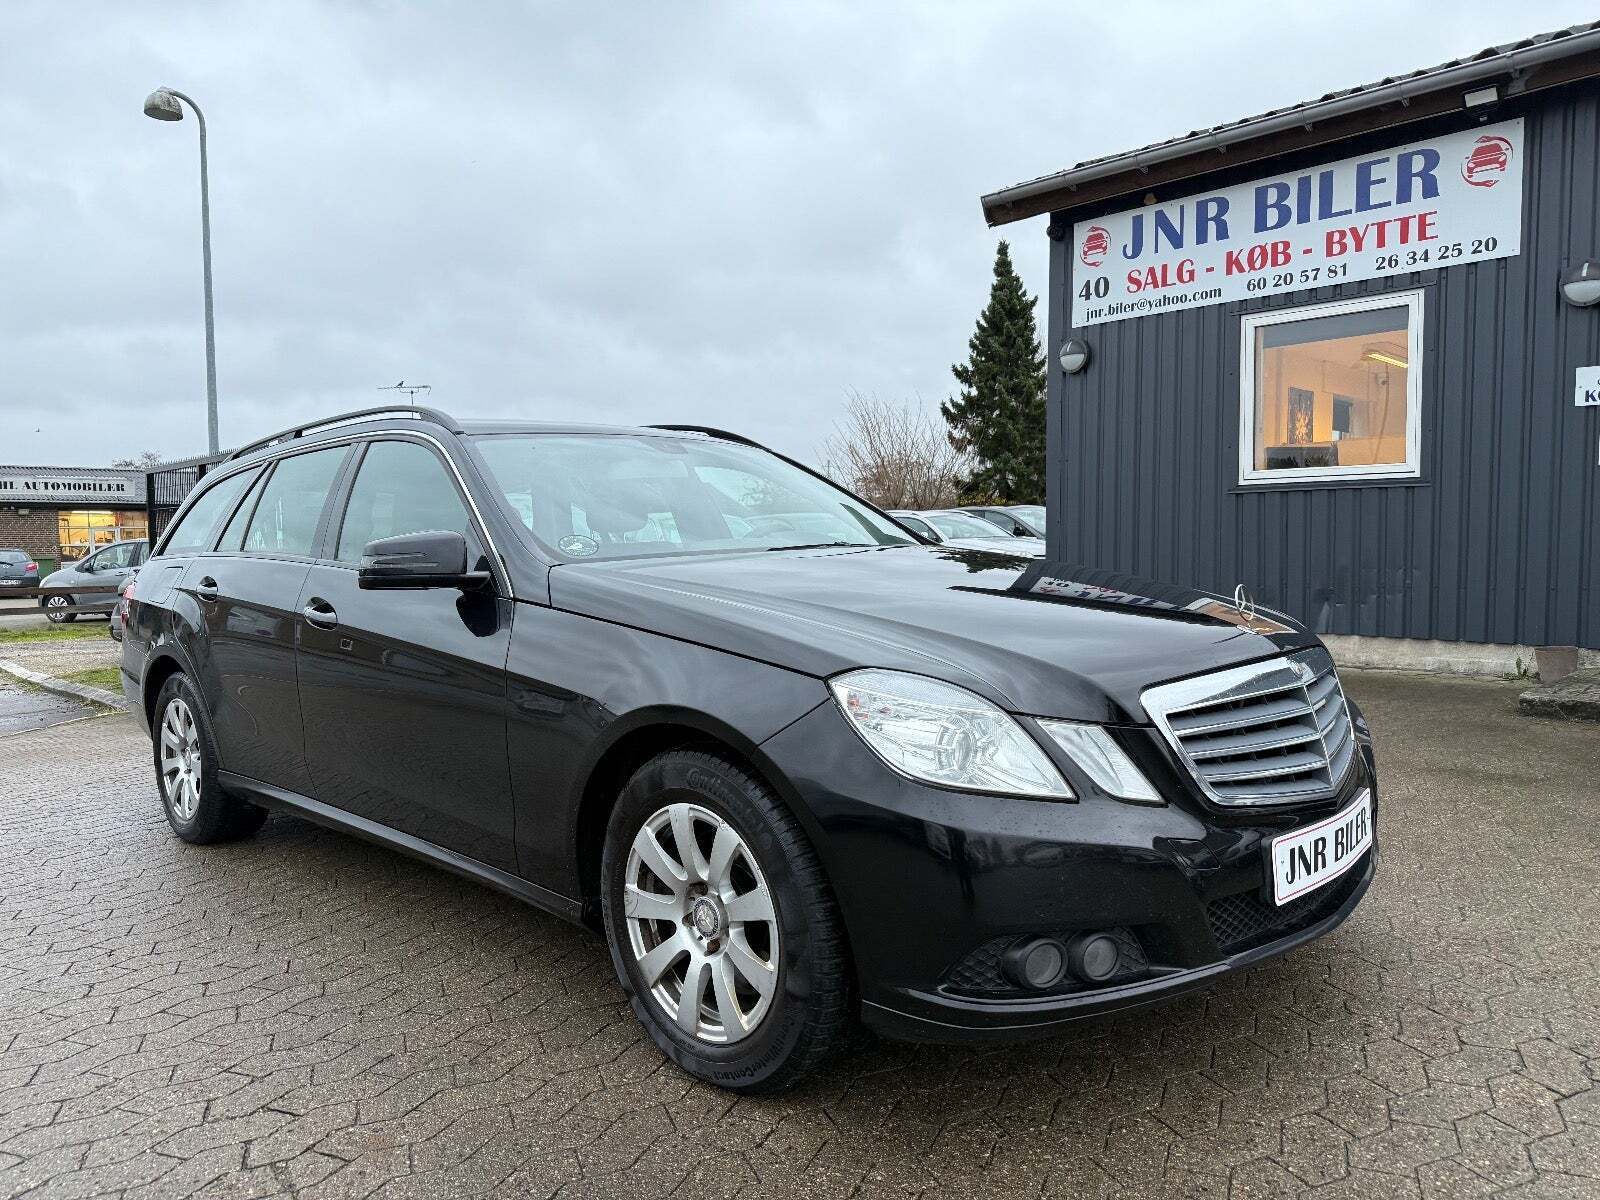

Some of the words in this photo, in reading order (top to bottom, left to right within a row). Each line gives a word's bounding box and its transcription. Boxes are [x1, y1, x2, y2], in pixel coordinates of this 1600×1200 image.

[1122, 197, 1230, 260] JNR
[1254, 149, 1440, 234] BILER
[1126, 259, 1196, 294] SALG
[1225, 240, 1292, 276] KØB
[1325, 211, 1439, 258] BYTTE
[1246, 276, 1267, 292] 60
[1272, 272, 1294, 288] 20
[1300, 268, 1321, 284] 57
[1327, 263, 1348, 279] 81
[1375, 254, 1399, 270] 26
[1406, 249, 1430, 266] 34
[1438, 243, 1463, 260] 25
[1471, 237, 1498, 255] 20
[1078, 276, 1110, 301] 40
[1085, 287, 1222, 322] jnr.biler@yahoo.com
[22, 481, 125, 492] AUTOMOBILER
[1286, 836, 1327, 884] JNR
[1335, 806, 1367, 862] BILER
